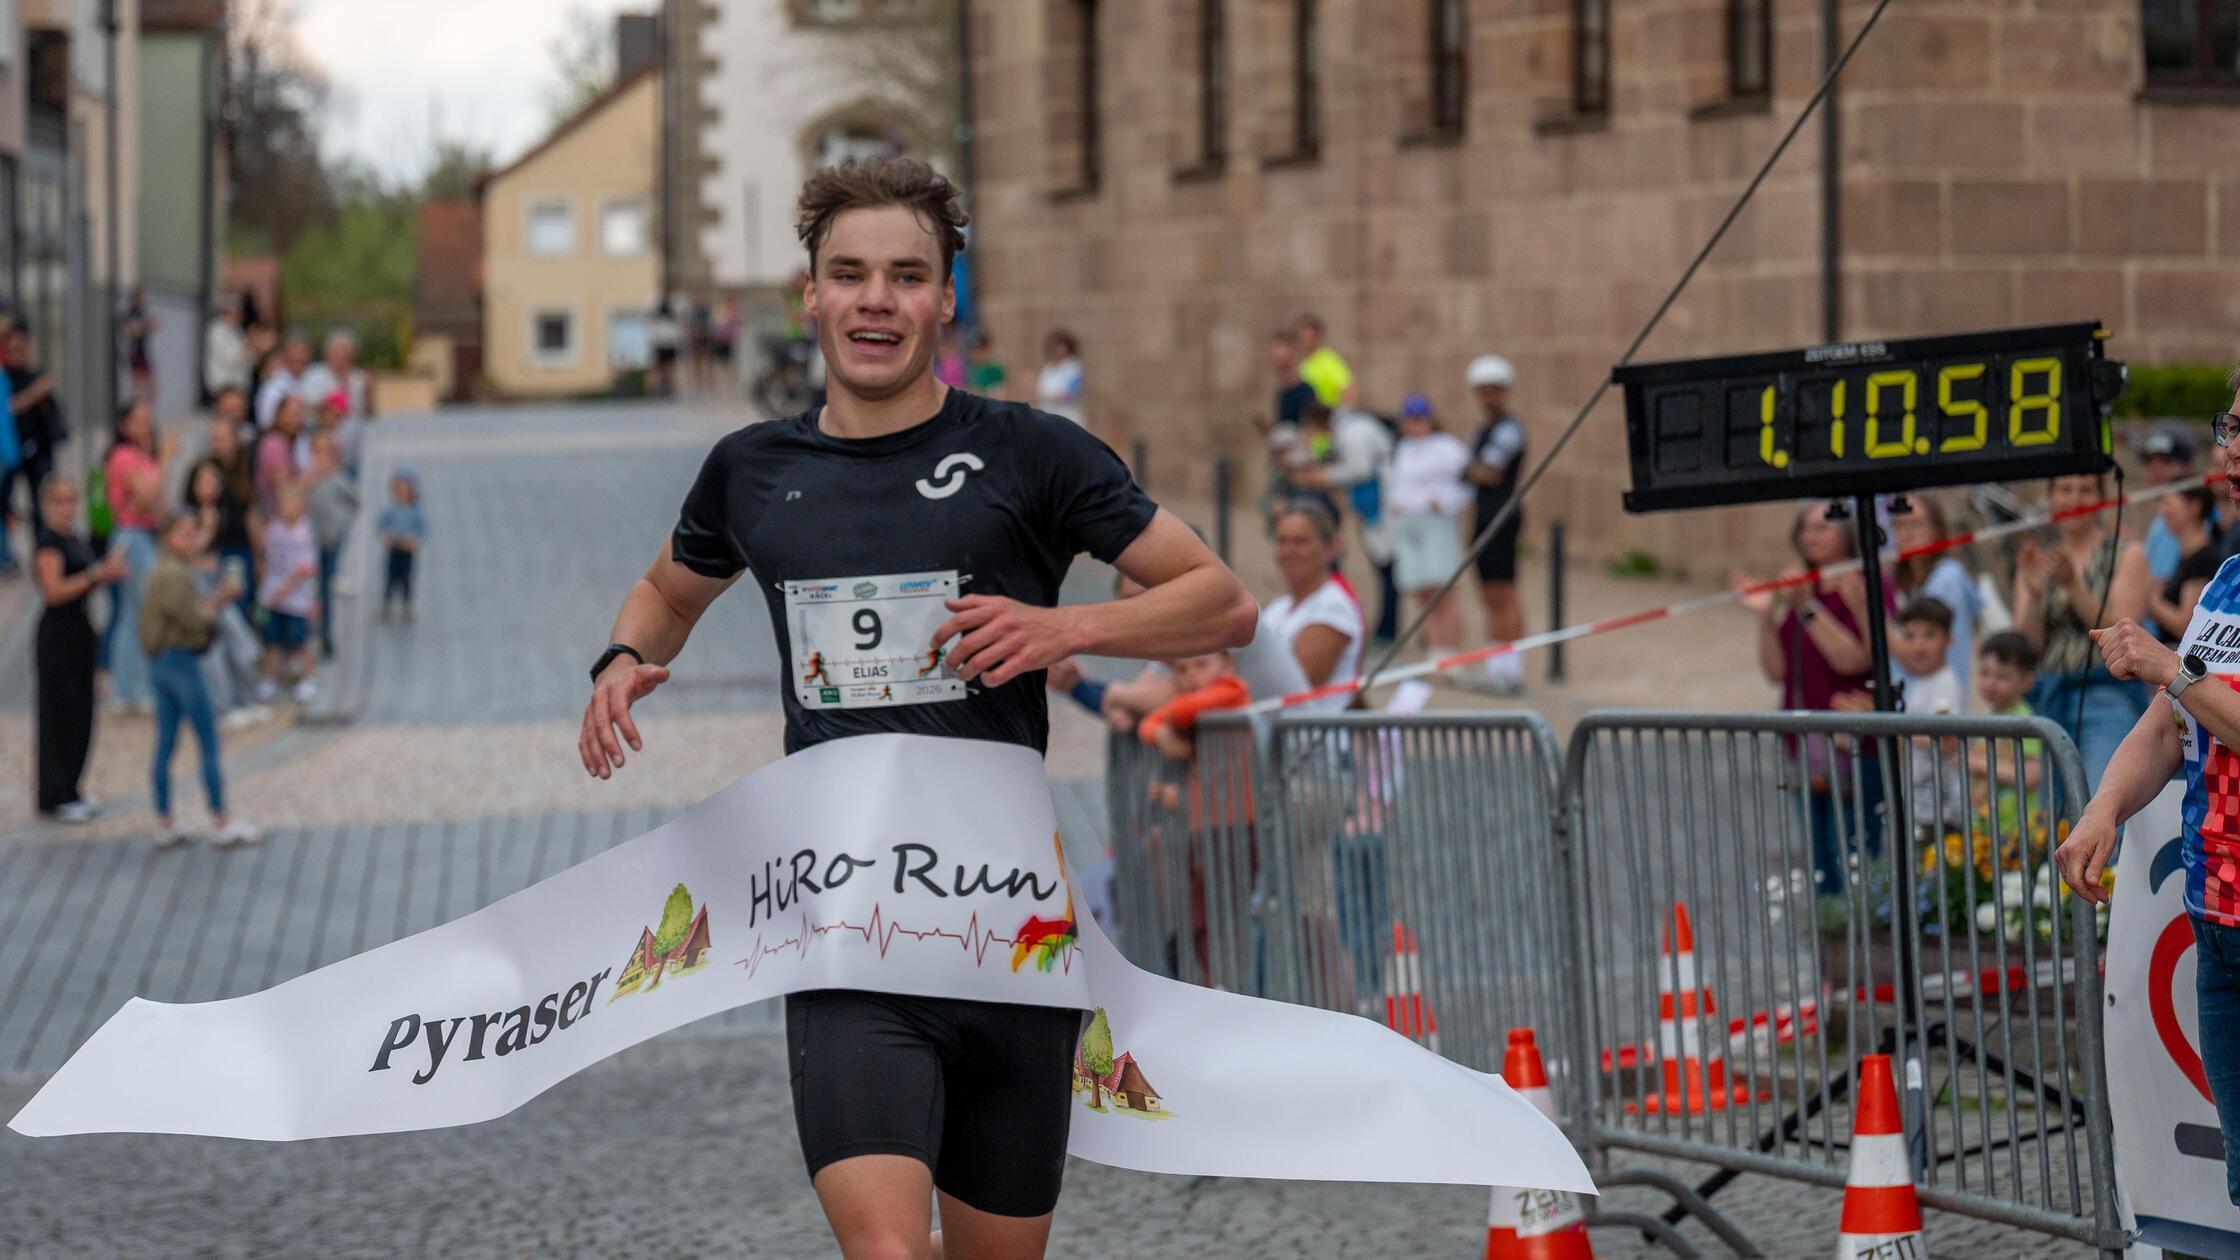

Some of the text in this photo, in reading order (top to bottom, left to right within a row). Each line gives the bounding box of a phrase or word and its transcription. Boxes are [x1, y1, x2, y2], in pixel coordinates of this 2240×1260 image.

[852, 608, 883, 651] 9
[2215, 624, 2240, 648] CA
[853, 665, 888, 679] ELIAS
[916, 685, 942, 696] 2026
[749, 842, 1057, 929] HiRo Run
[368, 966, 612, 1085] Pyraser
